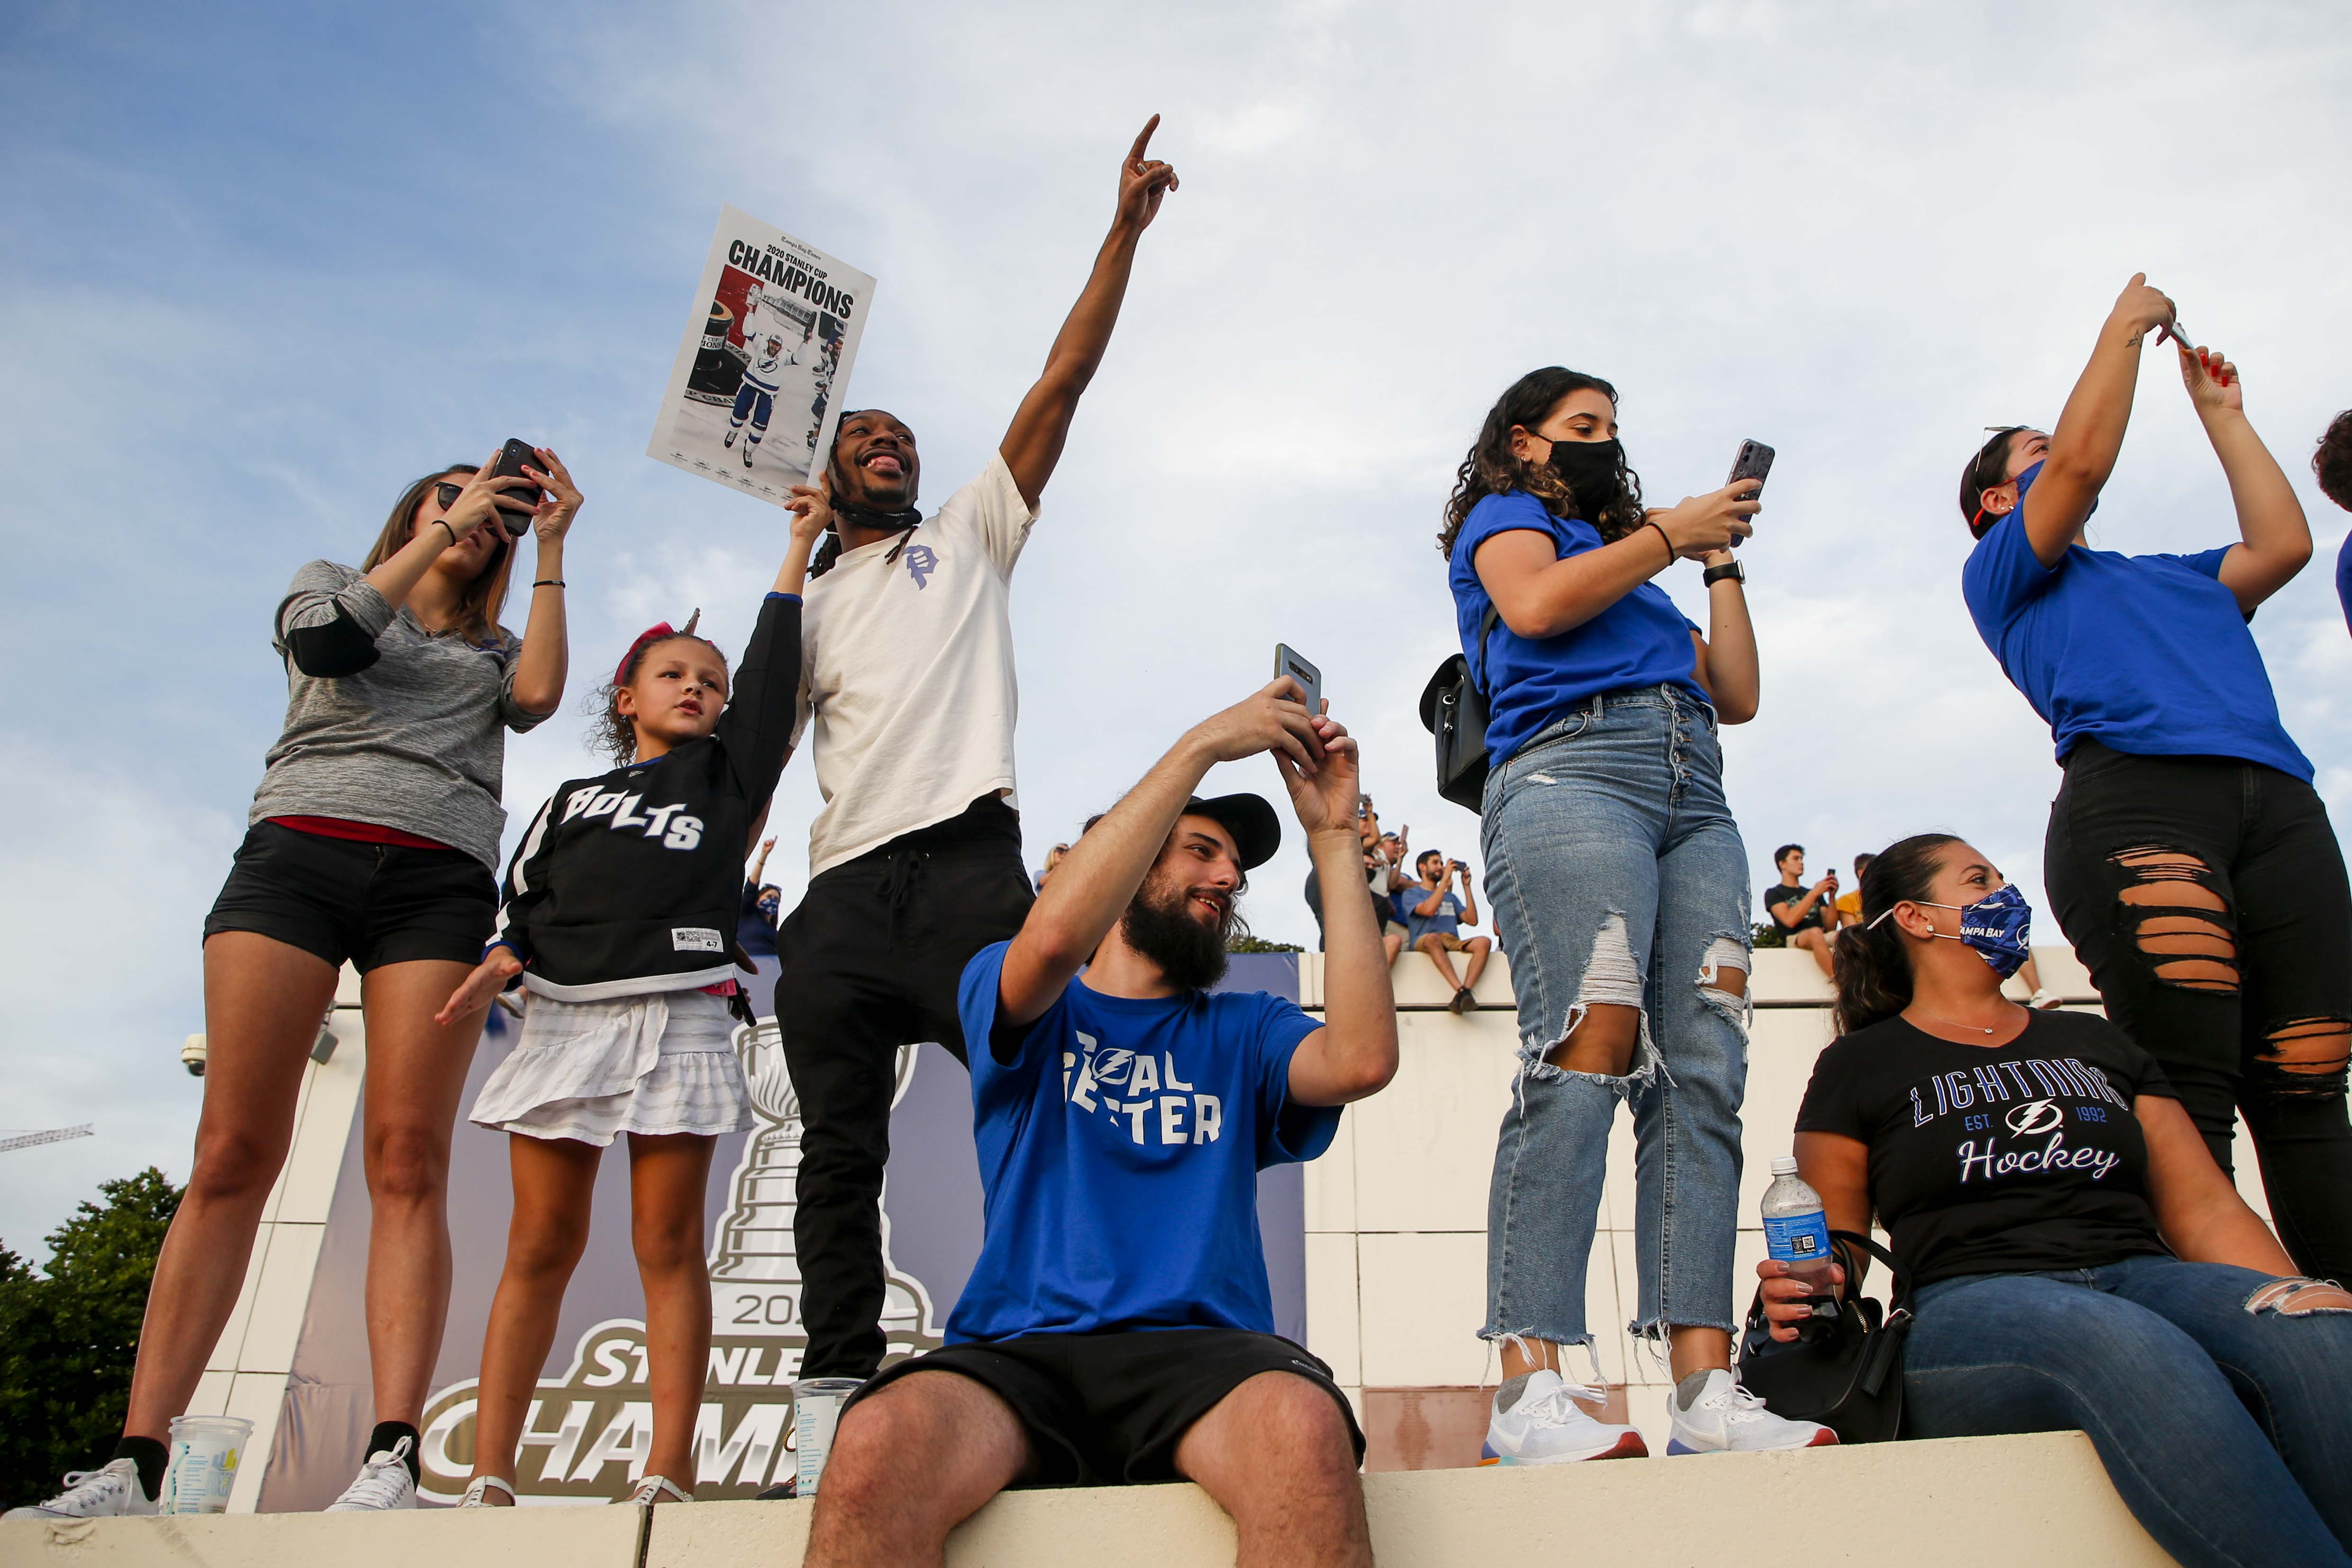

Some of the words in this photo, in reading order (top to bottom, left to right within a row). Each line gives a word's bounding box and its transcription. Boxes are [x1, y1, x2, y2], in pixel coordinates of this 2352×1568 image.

[728, 239, 853, 319] CHAMPIONS
[767, 244, 784, 258] 2020
[785, 253, 814, 273] STANLEY
[814, 268, 827, 279] CUP
[558, 785, 704, 851] BOLTS
[1960, 926, 1985, 936] AMPA
[1985, 927, 2005, 938] BAY
[1910, 1058, 2129, 1128] LIGHTNING
[1965, 1114, 1993, 1131] EST.
[2076, 1107, 2107, 1123] 1992
[1957, 1132, 2121, 1183] Hockey
[732, 1295, 803, 1325] 20
[583, 1339, 806, 1387] STNLE
[420, 1398, 796, 1486] CHAM
